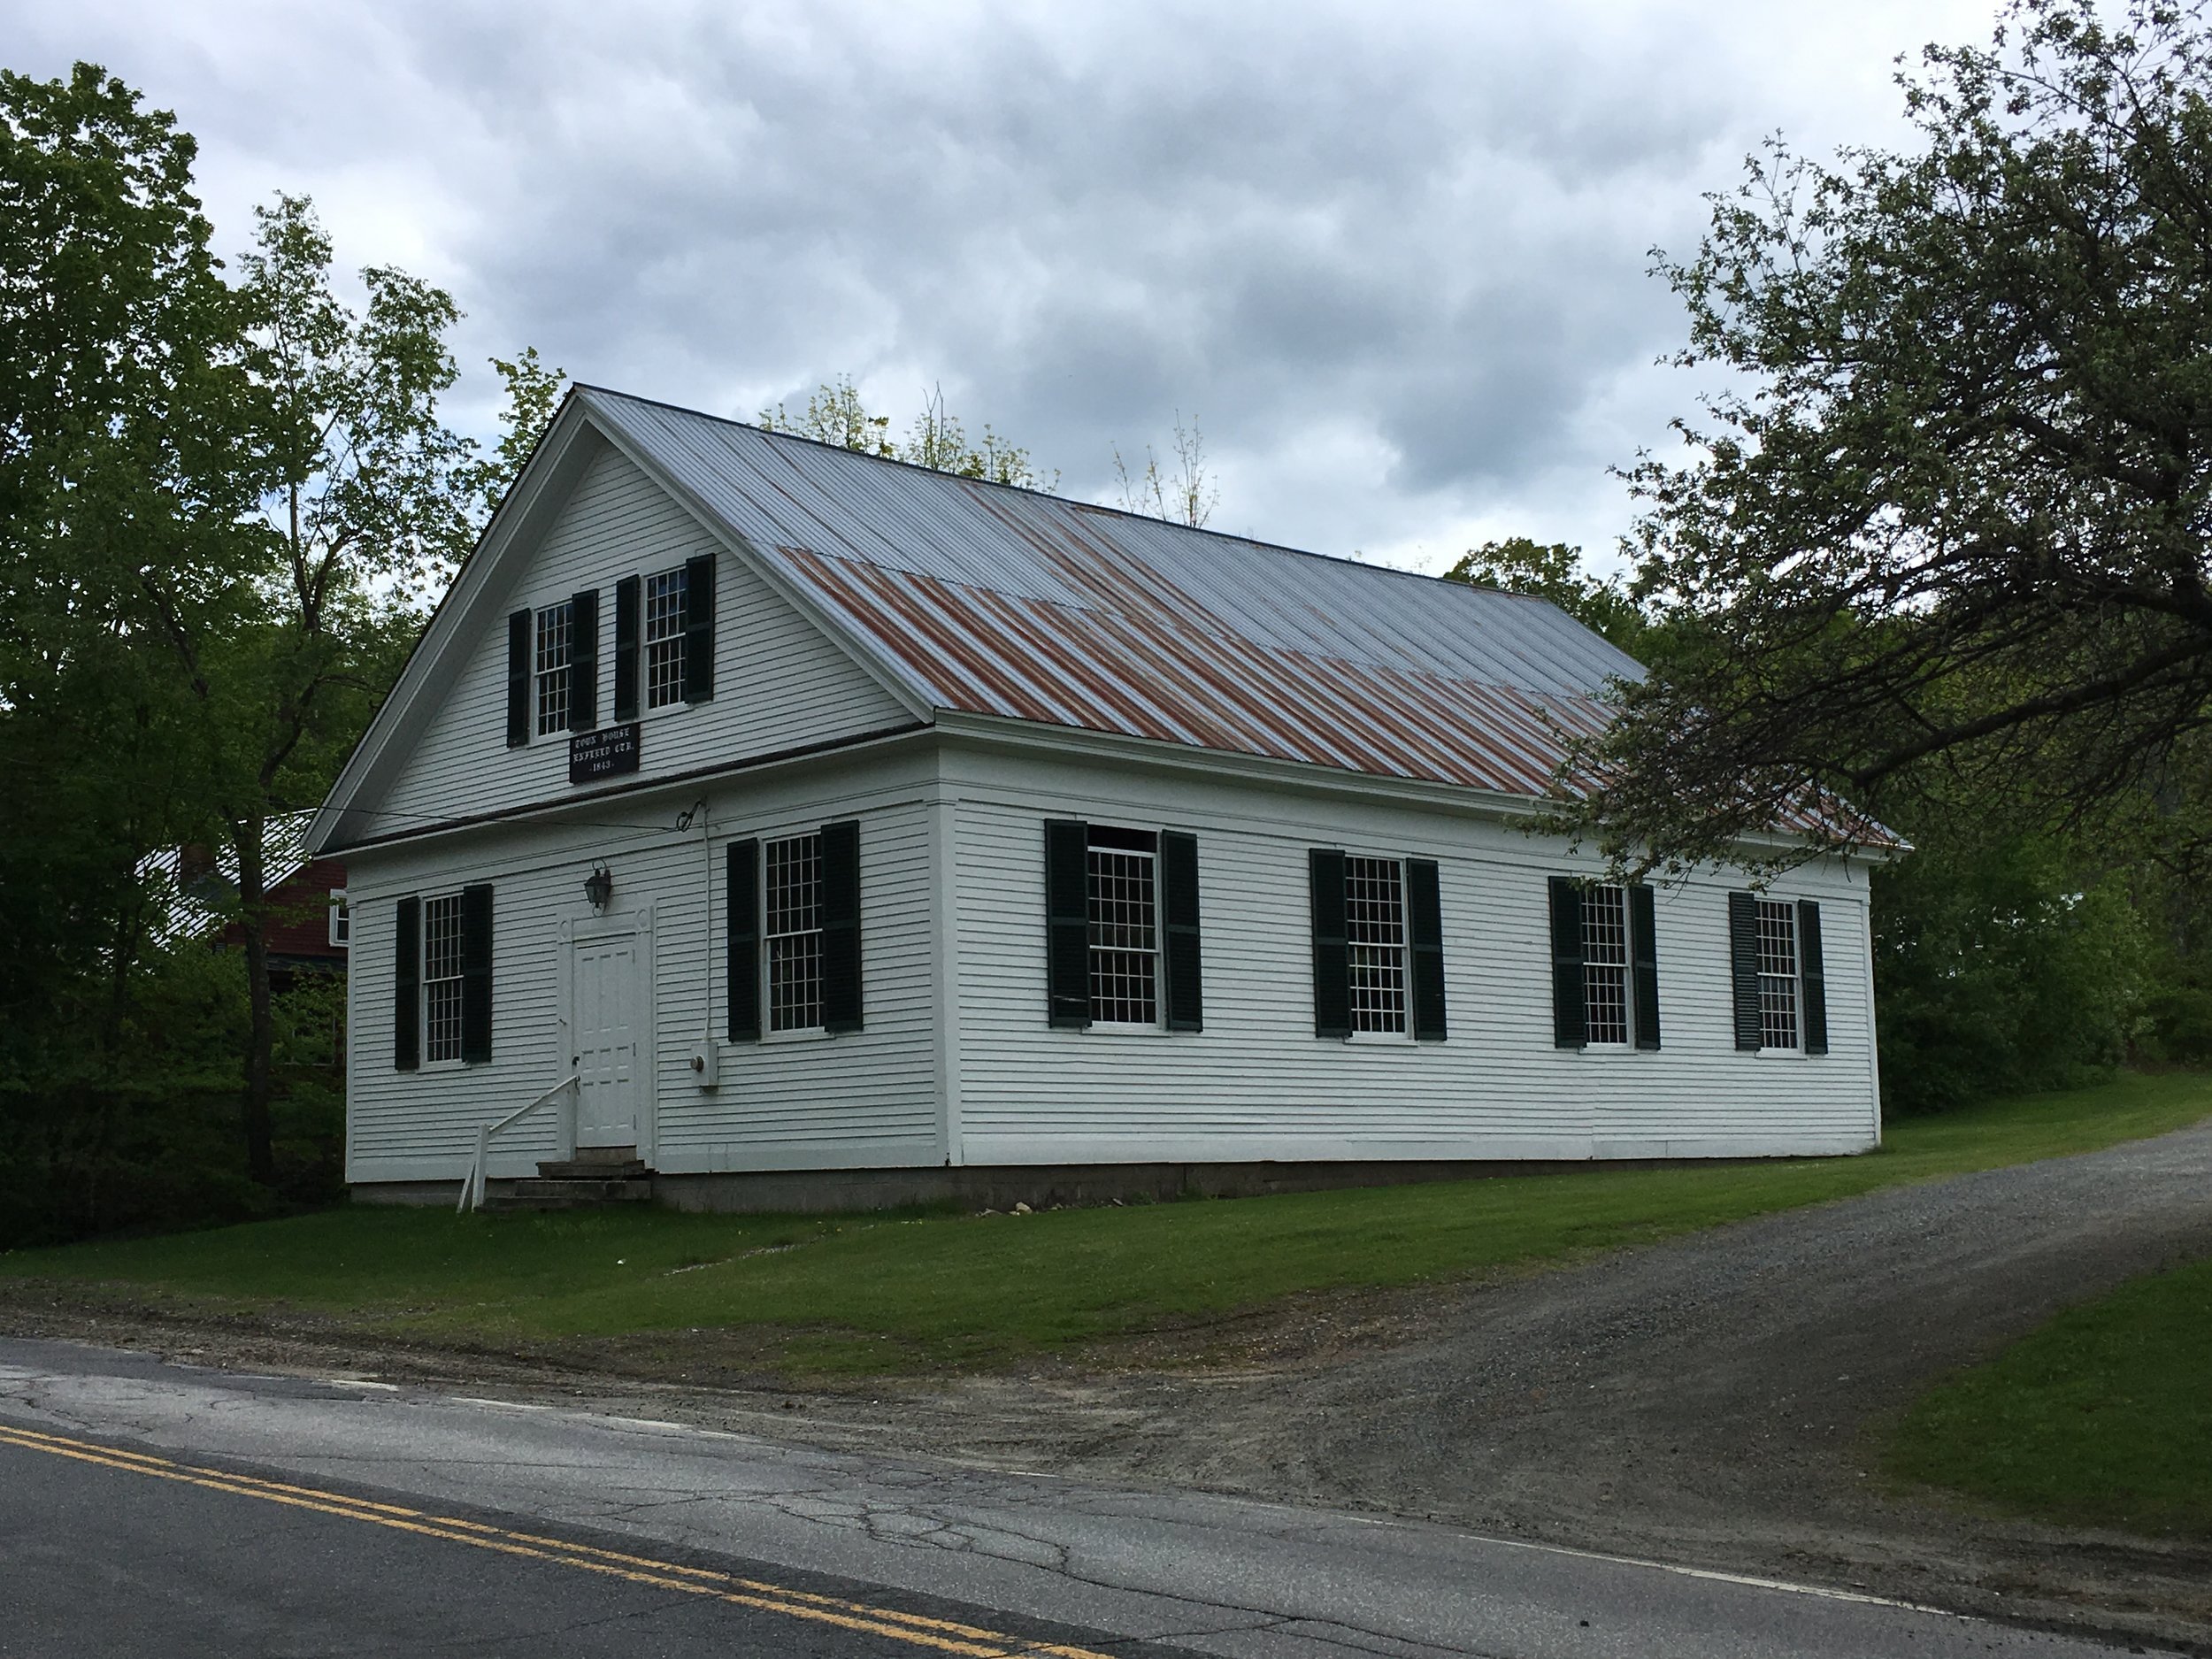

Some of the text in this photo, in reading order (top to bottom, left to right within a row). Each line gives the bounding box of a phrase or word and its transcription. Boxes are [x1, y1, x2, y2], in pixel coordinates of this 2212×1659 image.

[575, 727, 630, 749] TOWN HOUSE
[572, 746, 611, 763] ENFIELD
